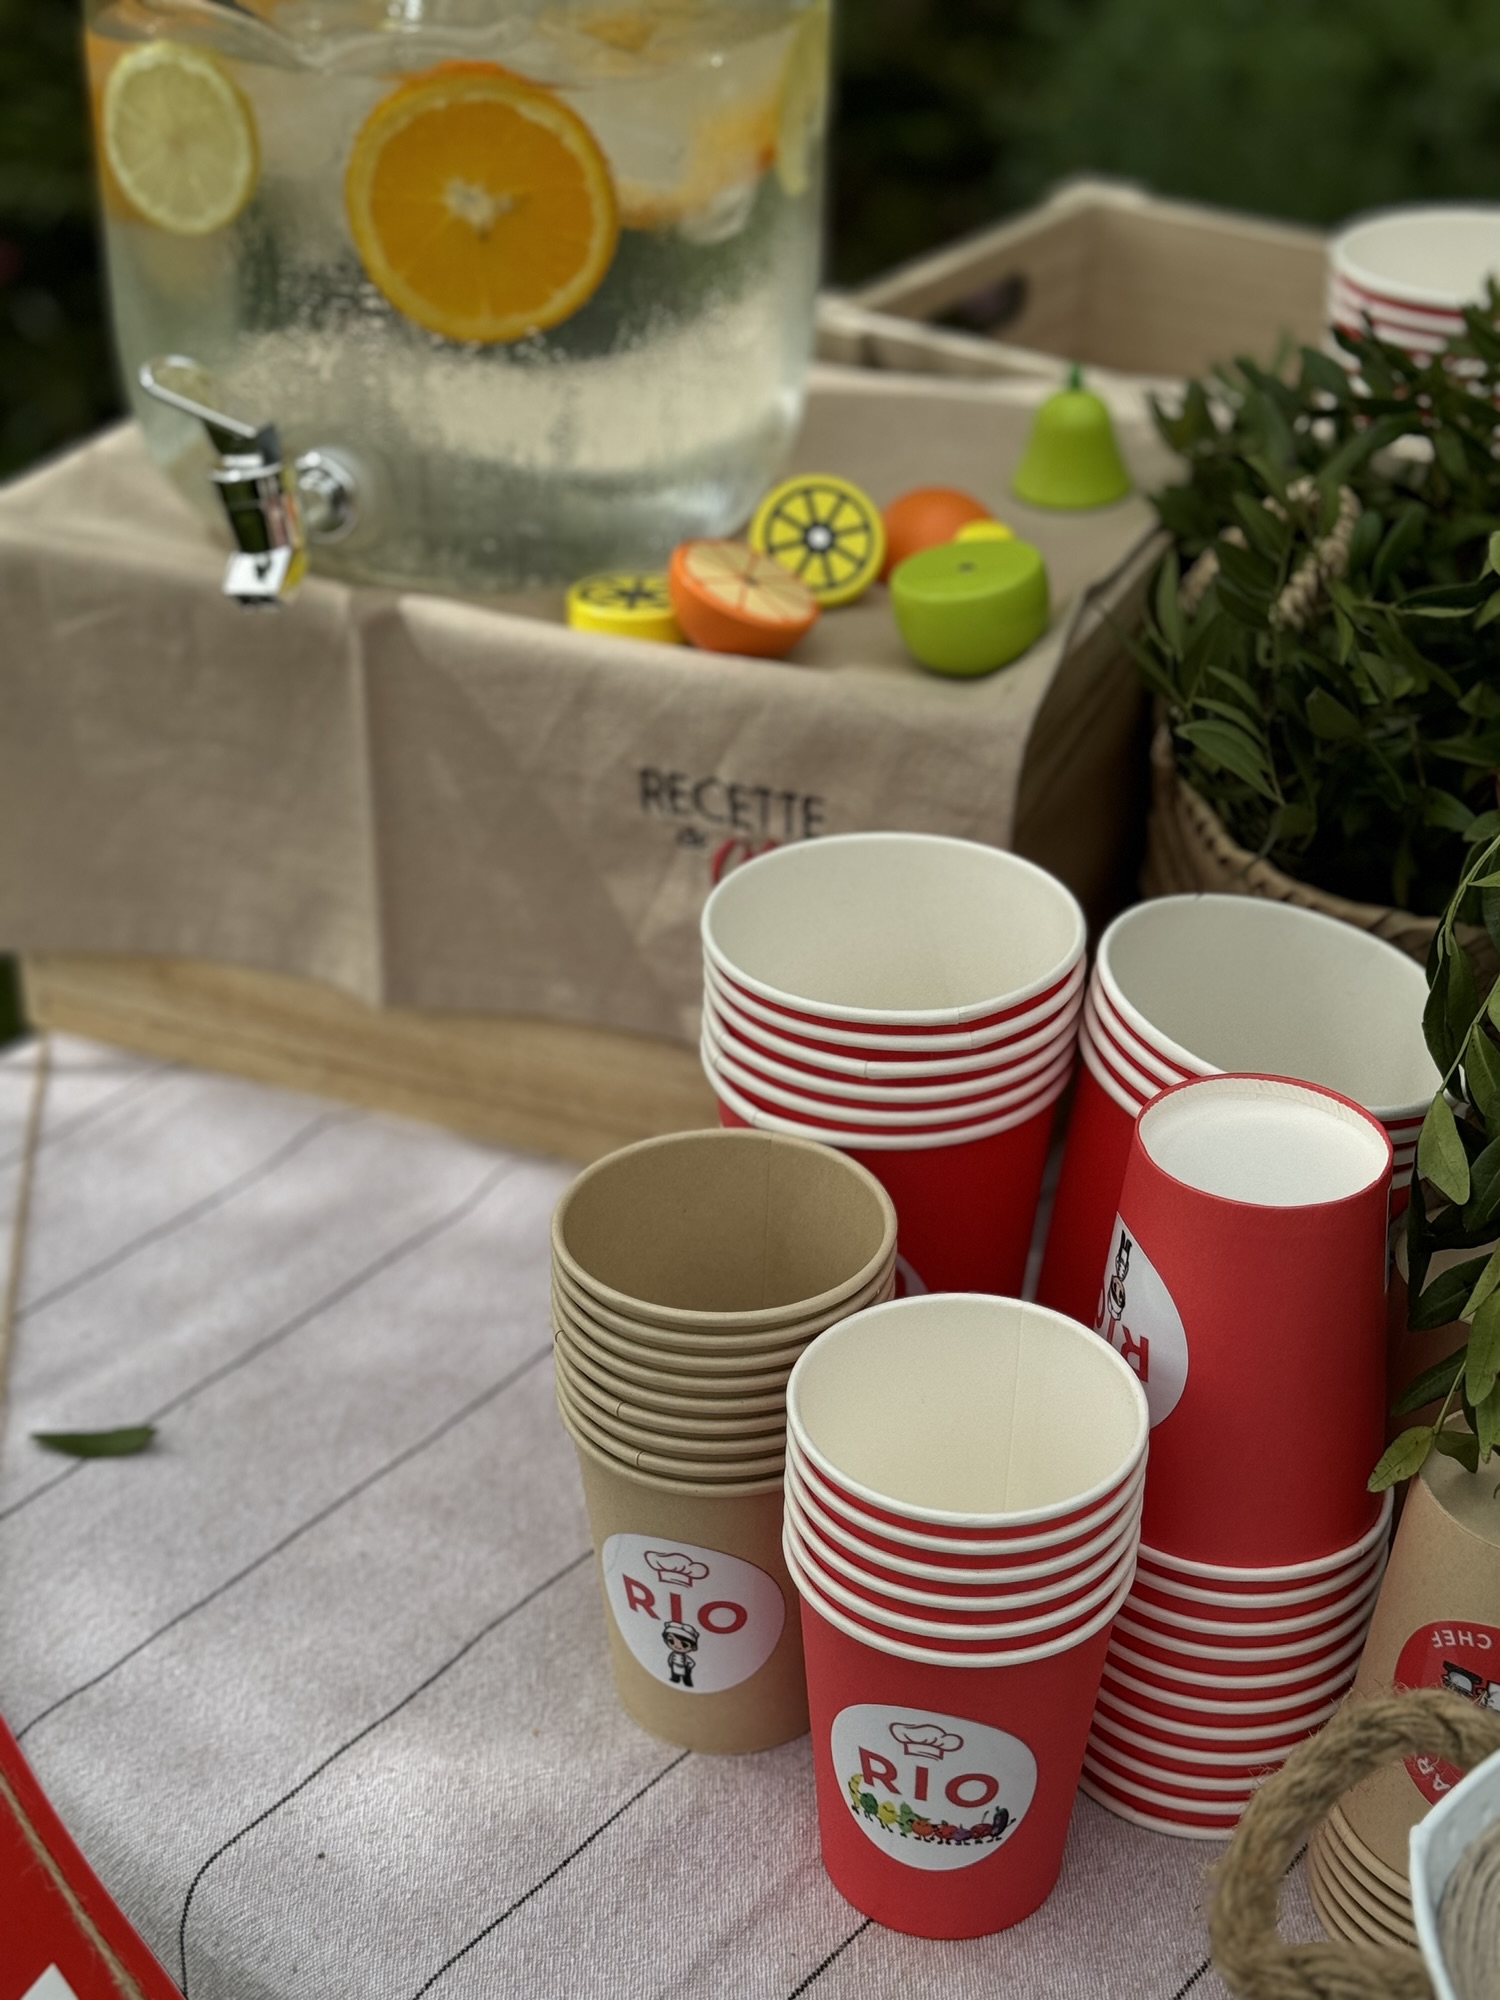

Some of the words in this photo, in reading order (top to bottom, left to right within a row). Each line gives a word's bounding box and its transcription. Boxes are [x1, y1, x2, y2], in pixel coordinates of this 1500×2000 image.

[639, 767, 826, 838] RECETTE
[622, 1573, 748, 1634] RIO
[1432, 1629, 1492, 1650] CHEF
[858, 1746, 999, 1808] RIO
